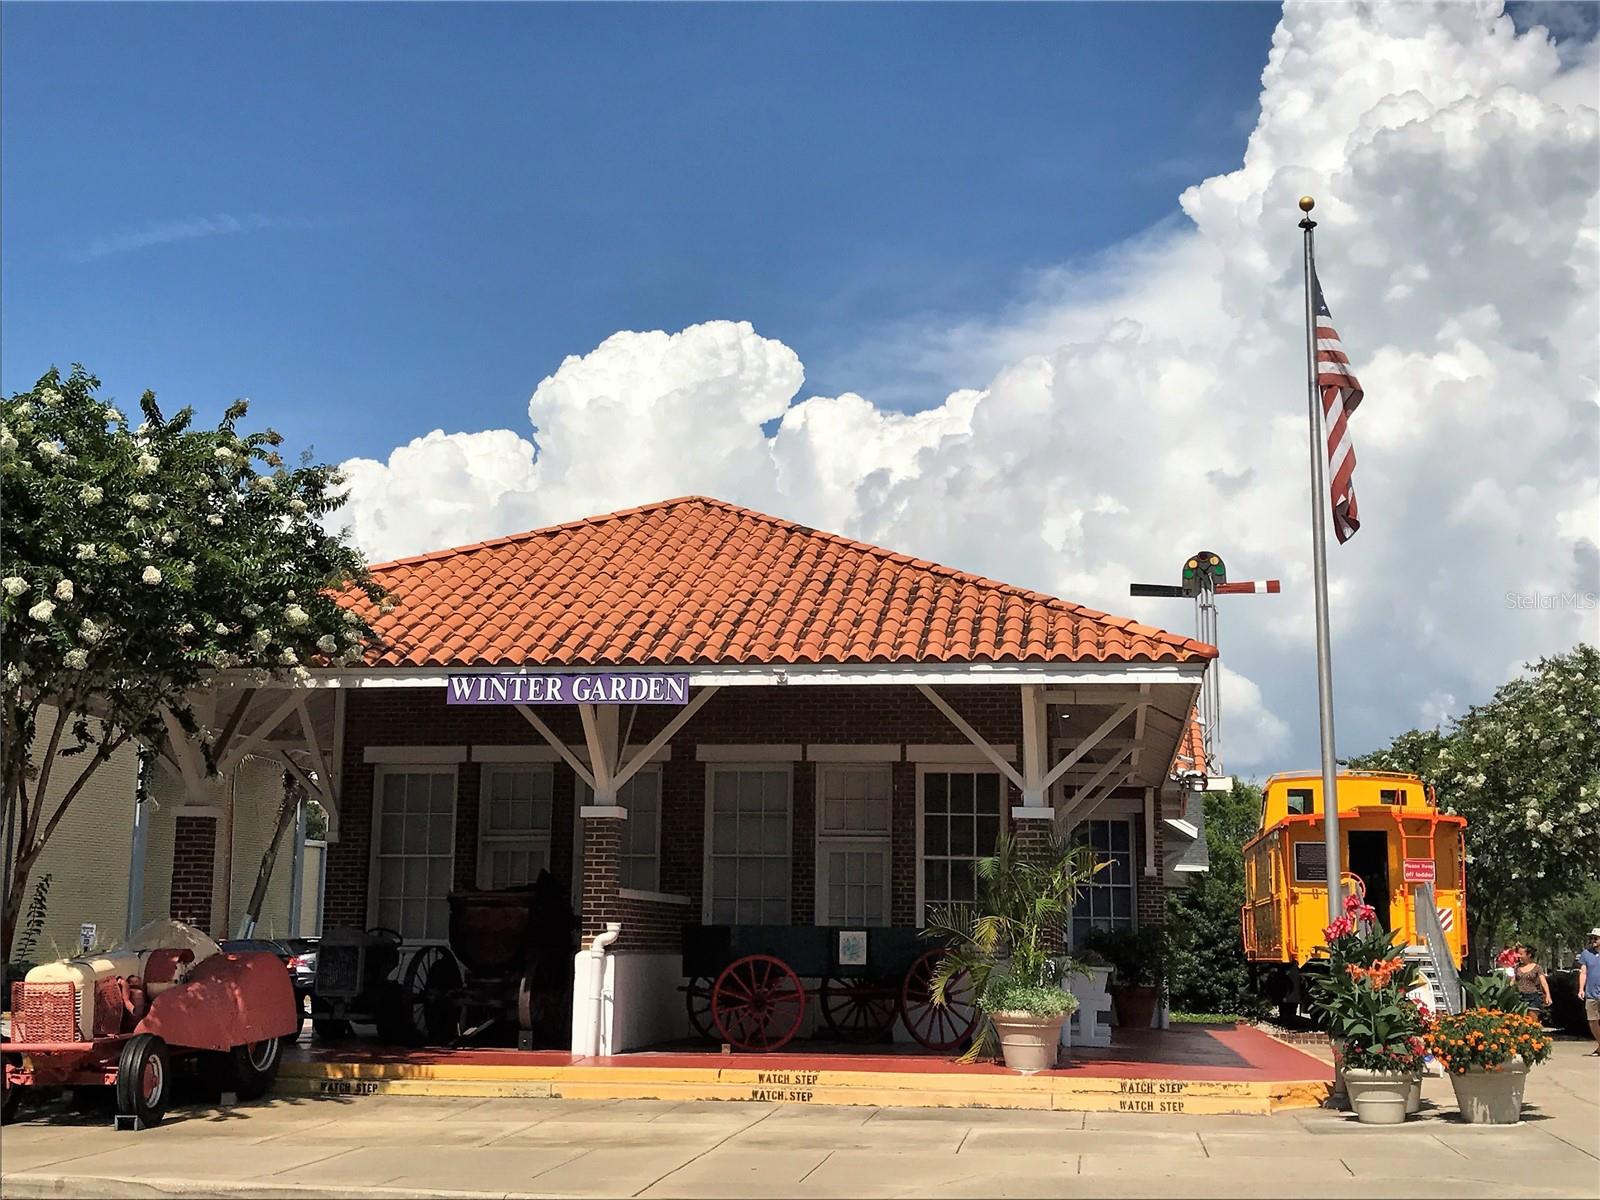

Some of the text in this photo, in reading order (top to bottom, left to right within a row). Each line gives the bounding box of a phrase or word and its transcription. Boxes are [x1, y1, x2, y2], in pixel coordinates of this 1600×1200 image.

[450, 676, 686, 701] WINTER GARDEN
[758, 1073, 818, 1085] WATCH STEP
[320, 1081, 378, 1093] WATCH STEP
[1120, 1082, 1183, 1093] WATCH STEP
[752, 1089, 813, 1102] WATCH STEP
[1119, 1100, 1184, 1111] WATCH STEP
